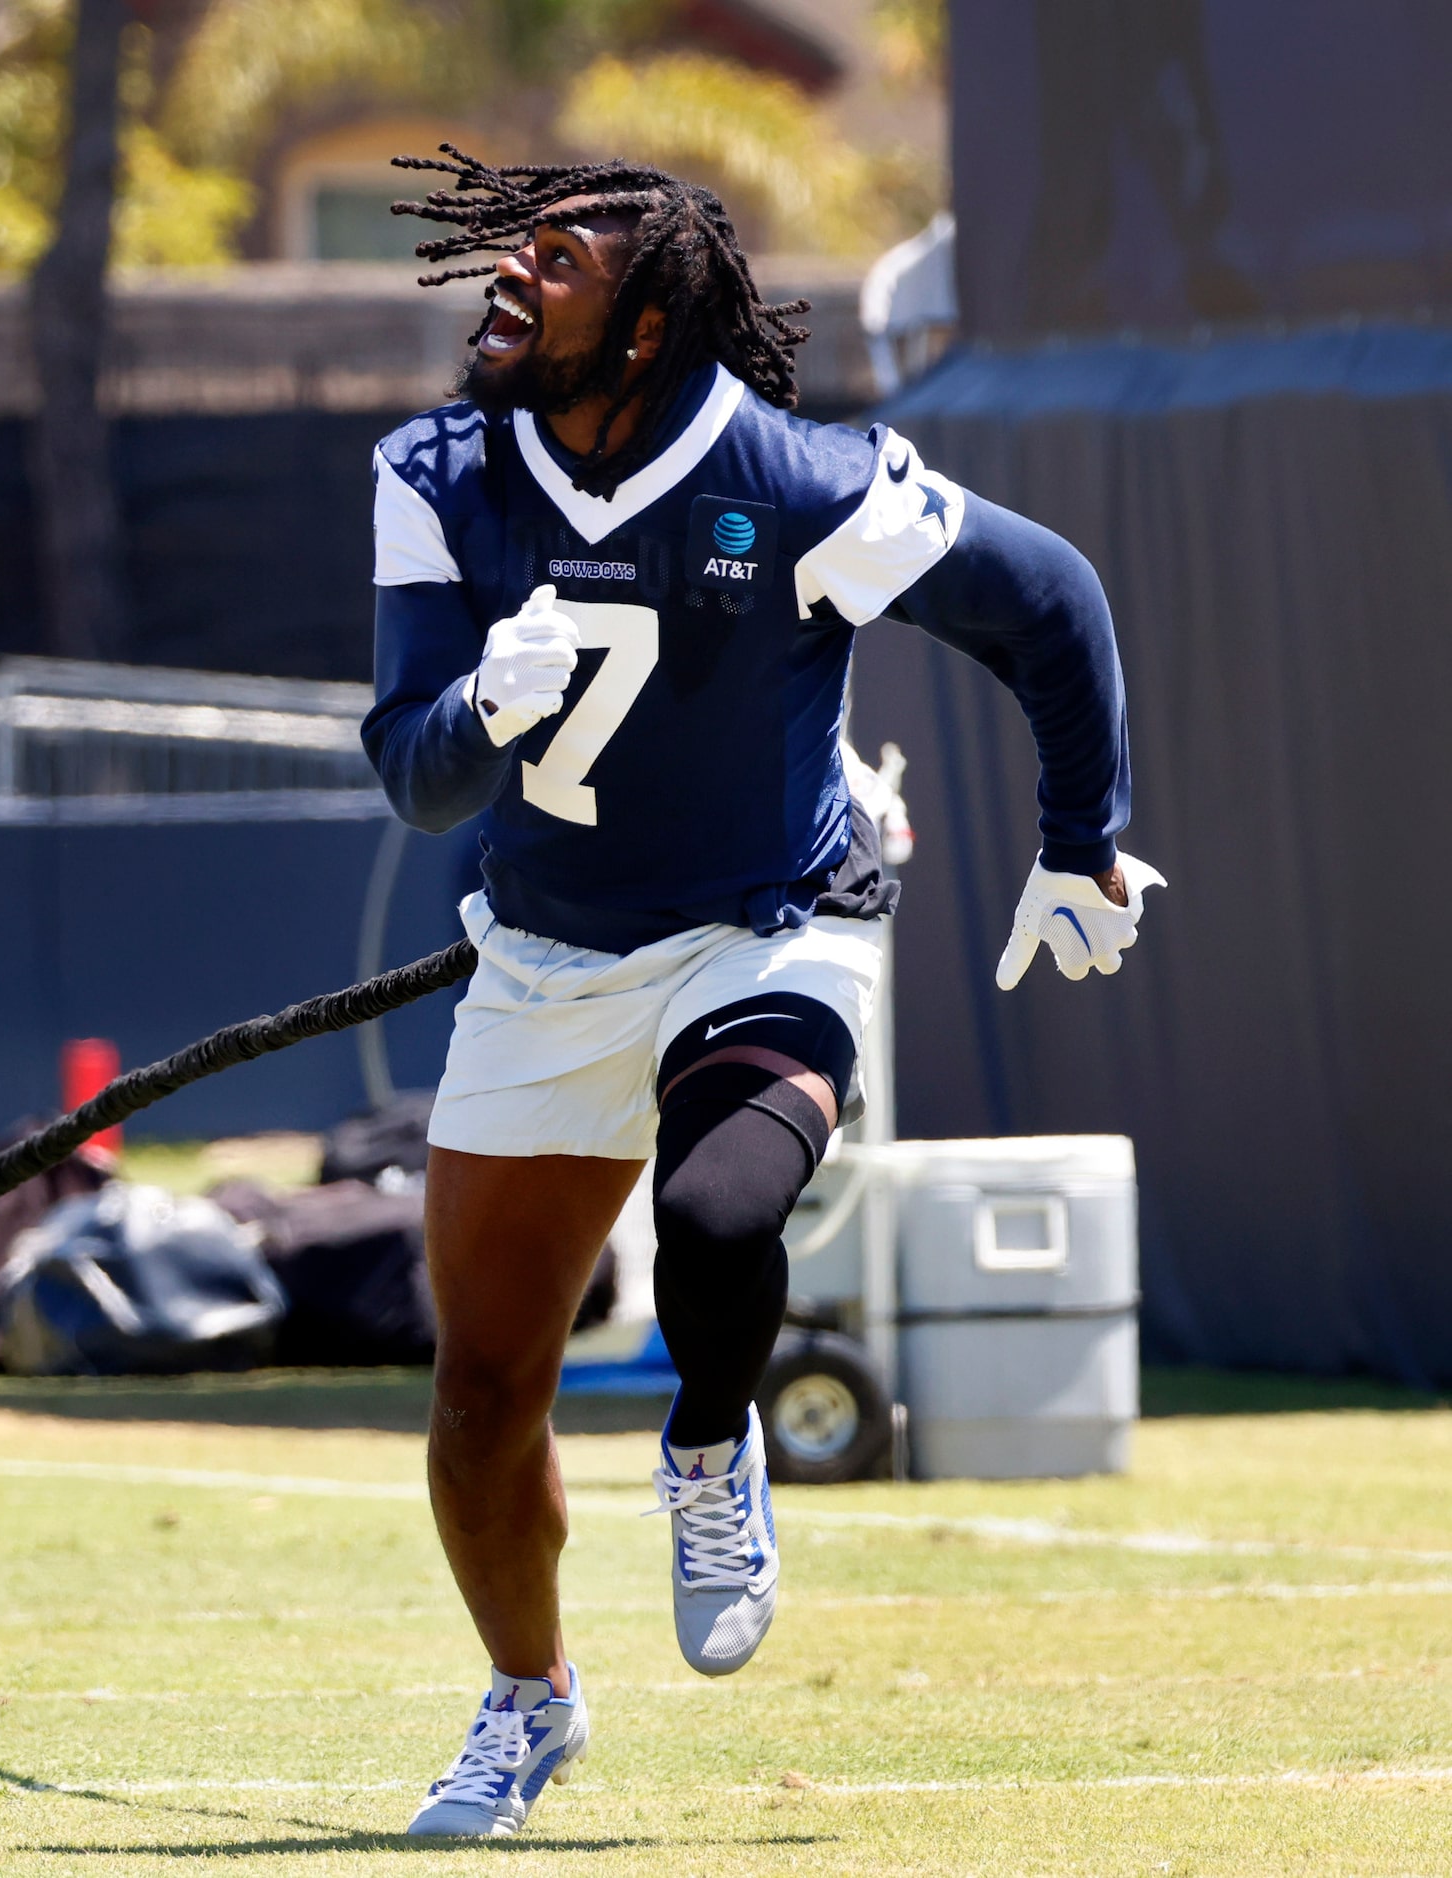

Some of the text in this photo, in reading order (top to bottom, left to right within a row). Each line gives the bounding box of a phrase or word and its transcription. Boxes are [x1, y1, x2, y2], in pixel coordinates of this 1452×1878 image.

[549, 559, 636, 580] COWBOYS
[703, 557, 758, 580] AT&T
[522, 599, 660, 826] 7
